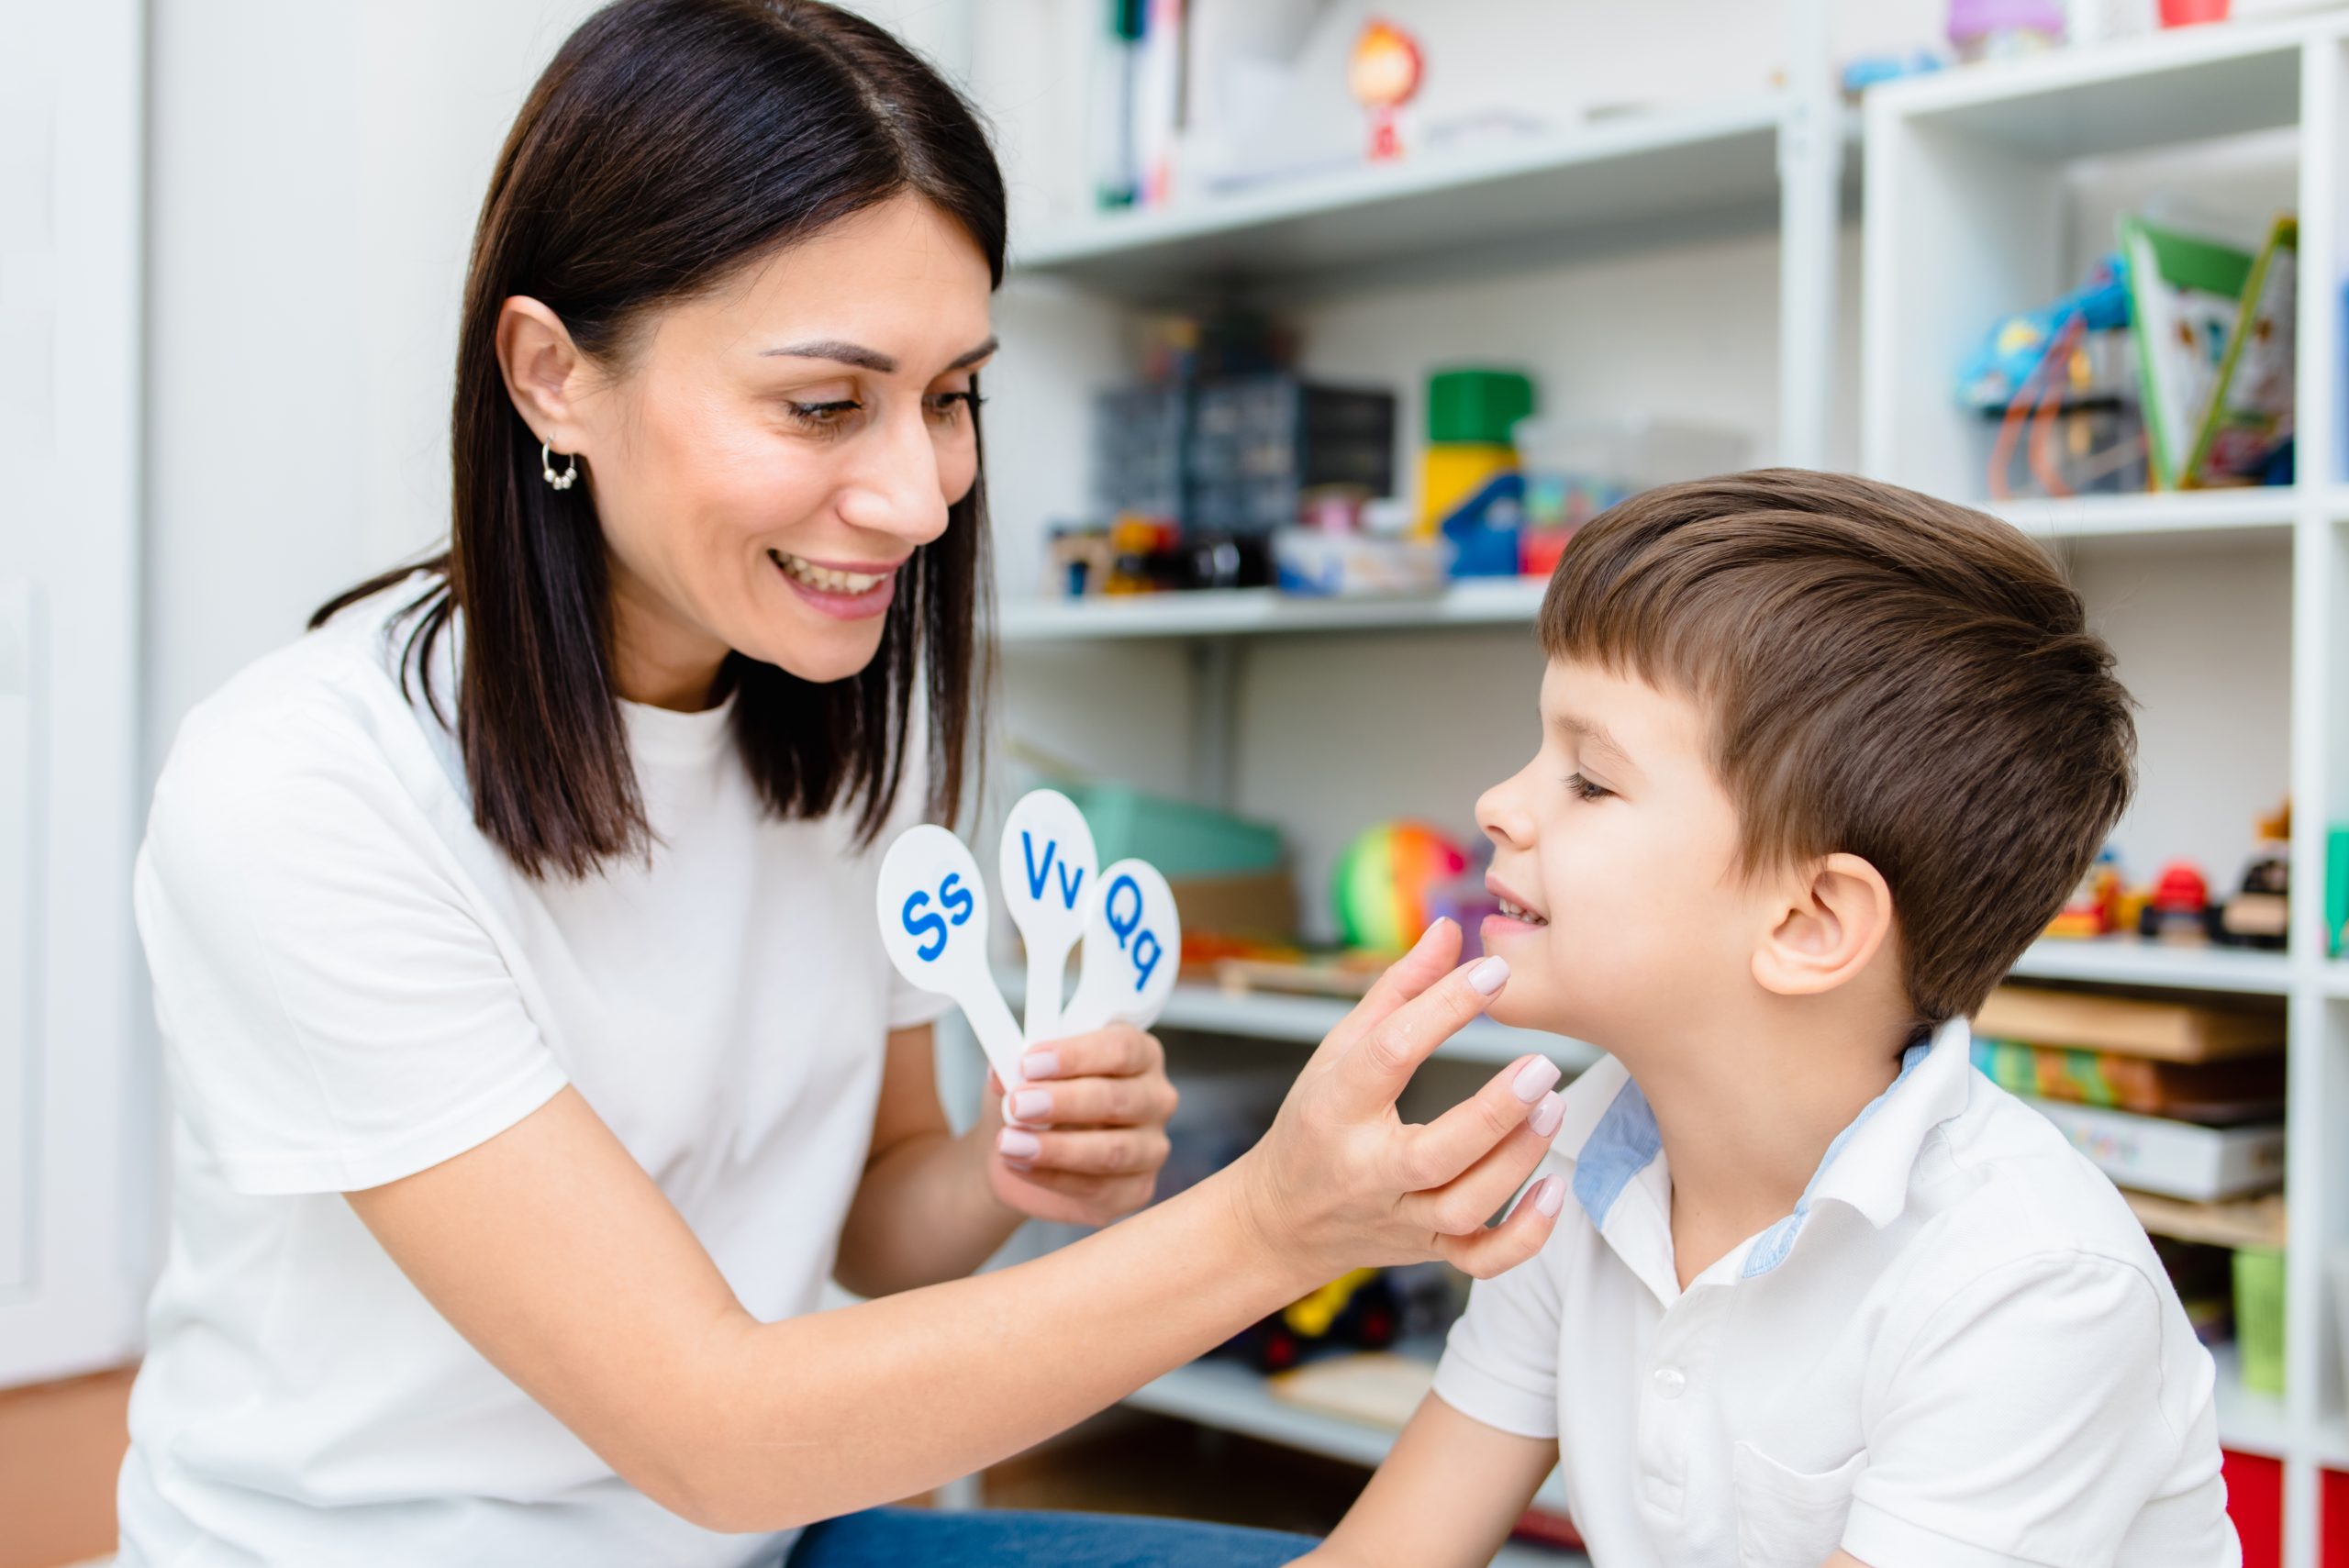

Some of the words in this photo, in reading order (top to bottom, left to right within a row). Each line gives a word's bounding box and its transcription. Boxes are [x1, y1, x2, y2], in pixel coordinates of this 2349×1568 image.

[1020, 829, 1085, 911] Vv
[901, 872, 974, 963] Ss
[1104, 873, 1163, 993] Qq
